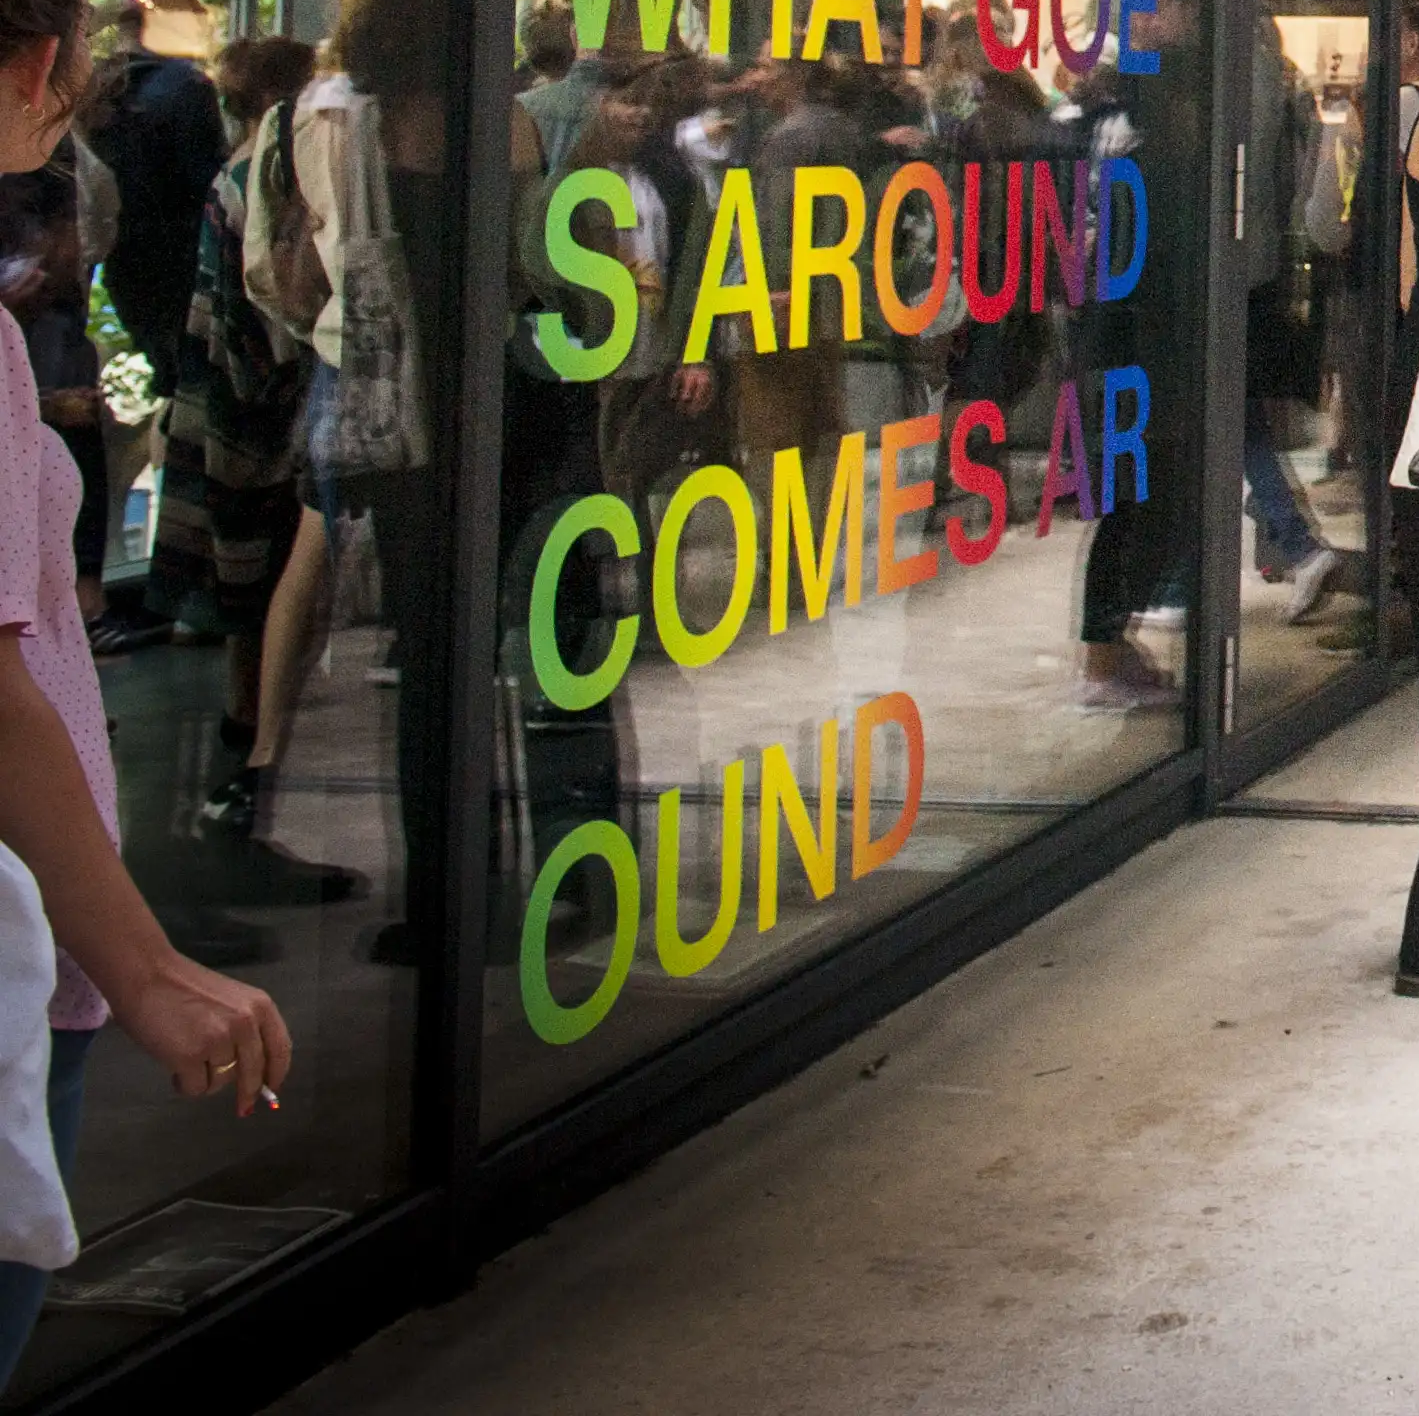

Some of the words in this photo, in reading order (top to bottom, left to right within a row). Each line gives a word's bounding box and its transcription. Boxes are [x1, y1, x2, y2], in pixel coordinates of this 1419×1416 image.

[536, 167, 639, 382] S
[682, 160, 1149, 365] AROUND
[529, 399, 1007, 711] COMES
[1036, 365, 1151, 538] AR
[520, 691, 926, 1046] OUND
